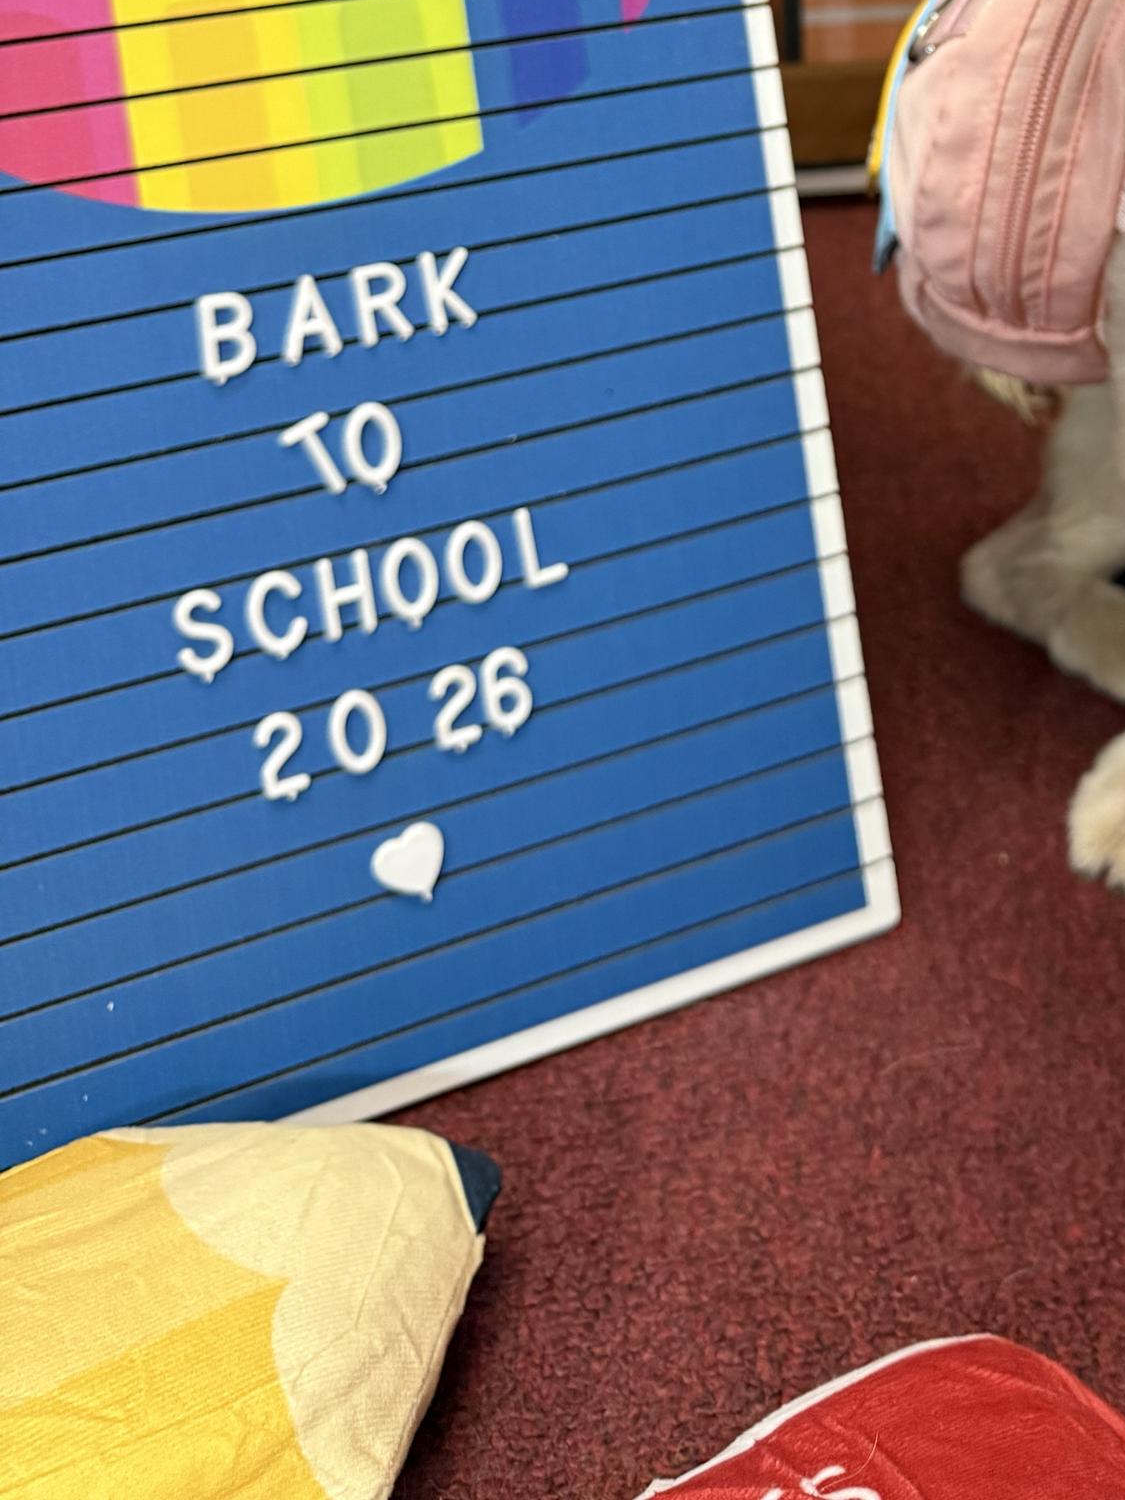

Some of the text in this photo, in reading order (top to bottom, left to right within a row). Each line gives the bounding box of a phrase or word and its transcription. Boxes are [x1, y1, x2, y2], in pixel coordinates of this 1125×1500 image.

[197, 246, 478, 385] BARK
[278, 401, 403, 494] TO
[173, 507, 569, 683] SCHOOL
